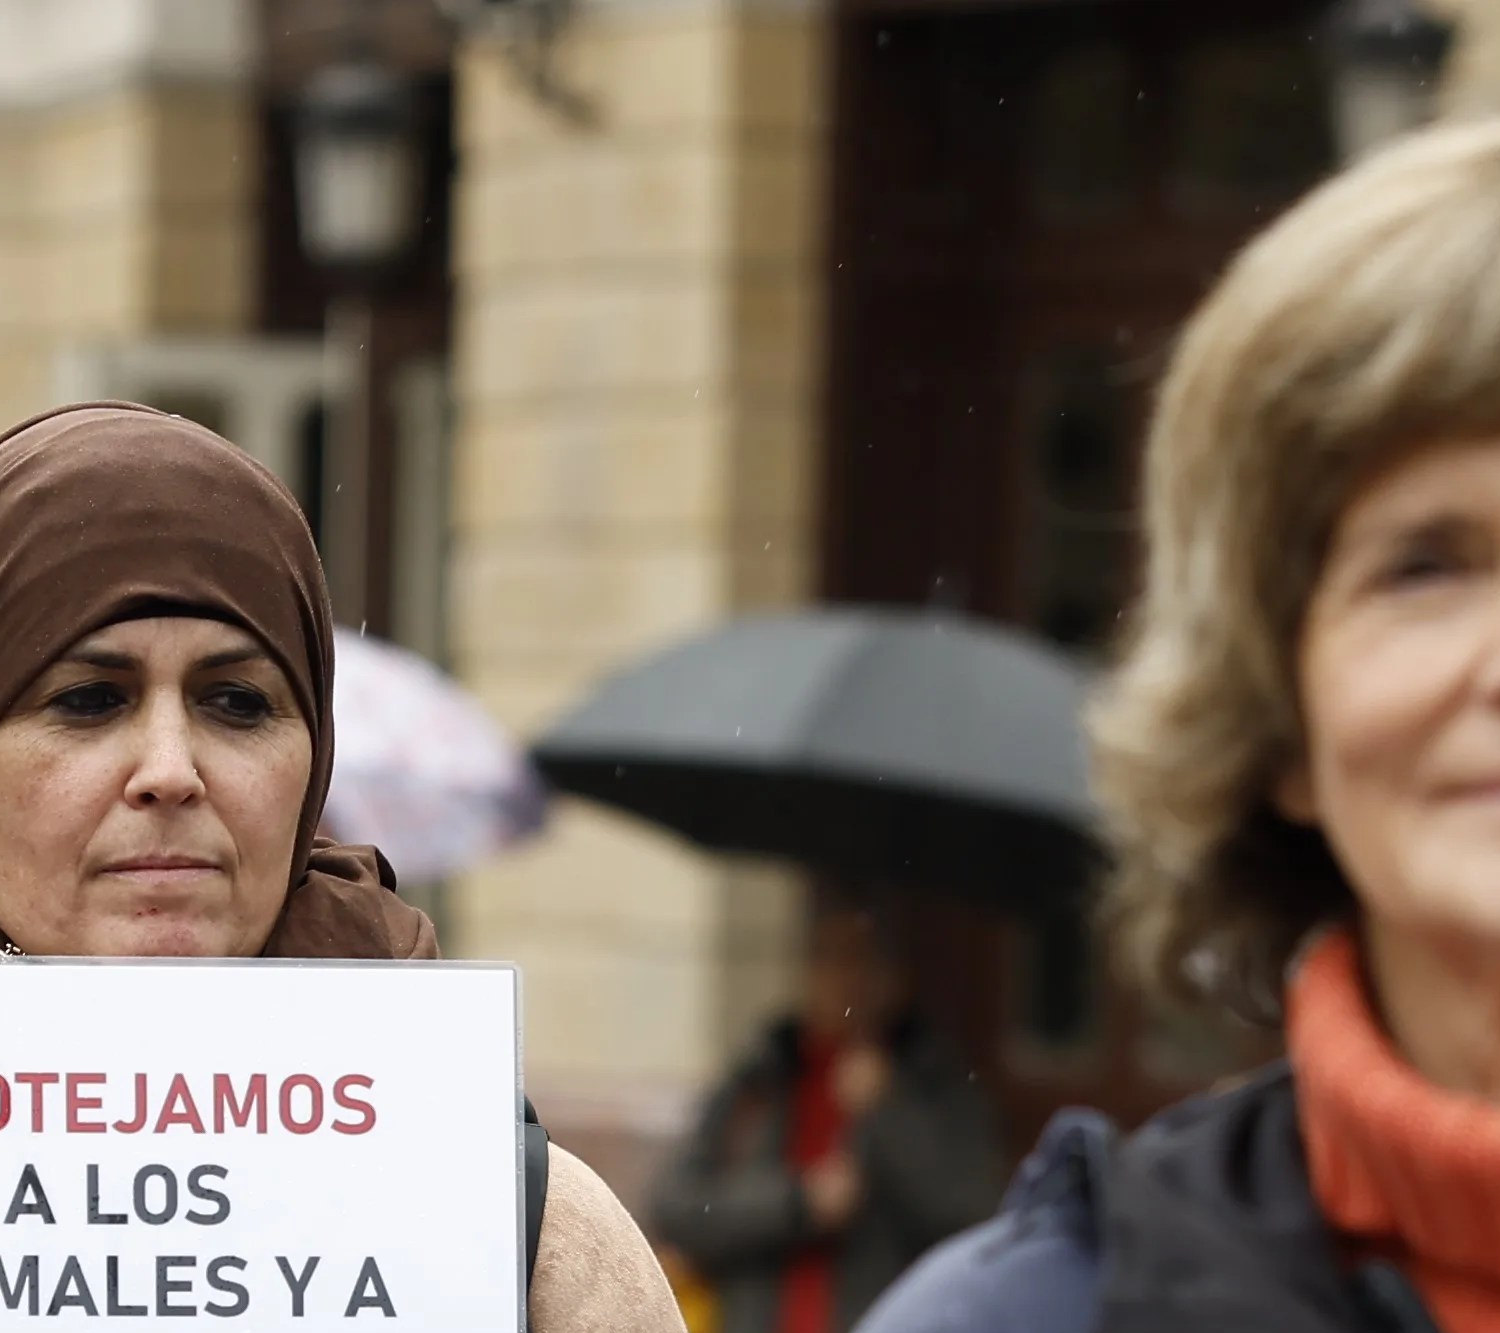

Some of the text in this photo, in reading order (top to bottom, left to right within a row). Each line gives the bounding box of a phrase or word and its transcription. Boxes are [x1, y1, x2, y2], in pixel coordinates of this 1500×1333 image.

[4, 1164, 230, 1225] A LOS
[275, 1256, 320, 1317] Y
[344, 1257, 396, 1317] A
